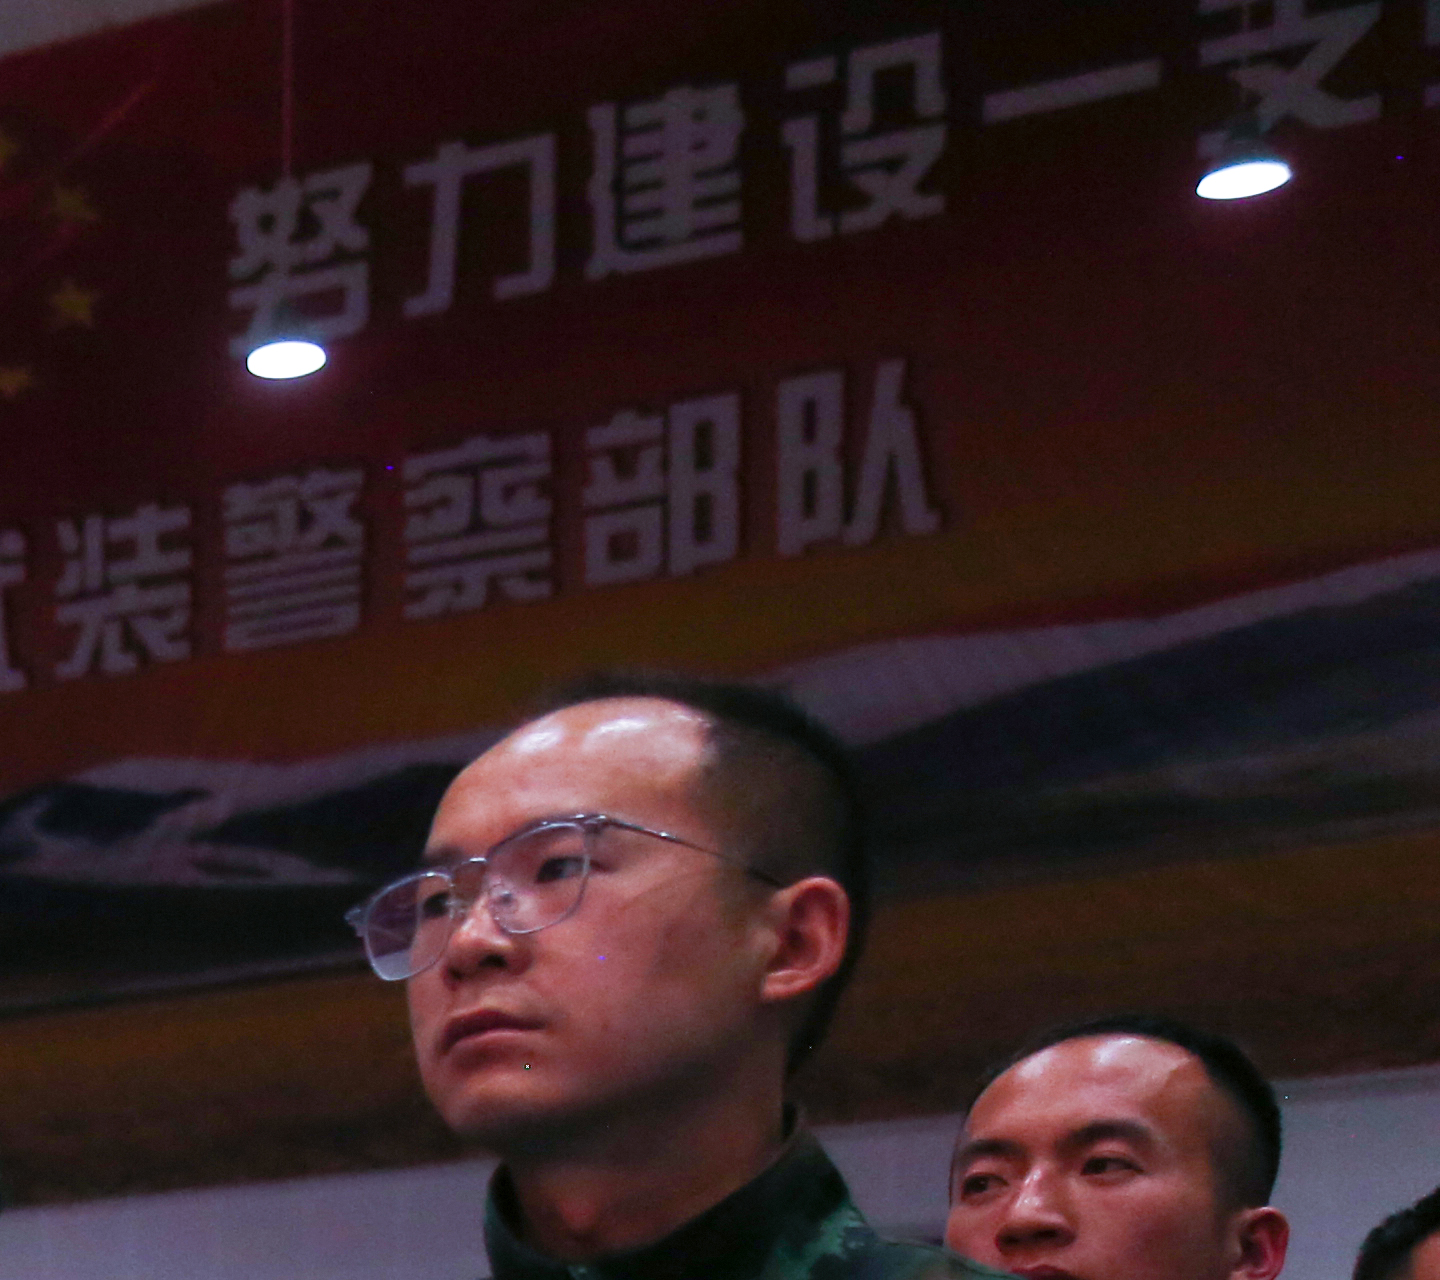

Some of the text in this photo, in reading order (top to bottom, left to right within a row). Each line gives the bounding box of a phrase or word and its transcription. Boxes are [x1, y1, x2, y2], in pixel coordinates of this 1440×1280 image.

[228, 0, 1440, 354] 努力建设一支
